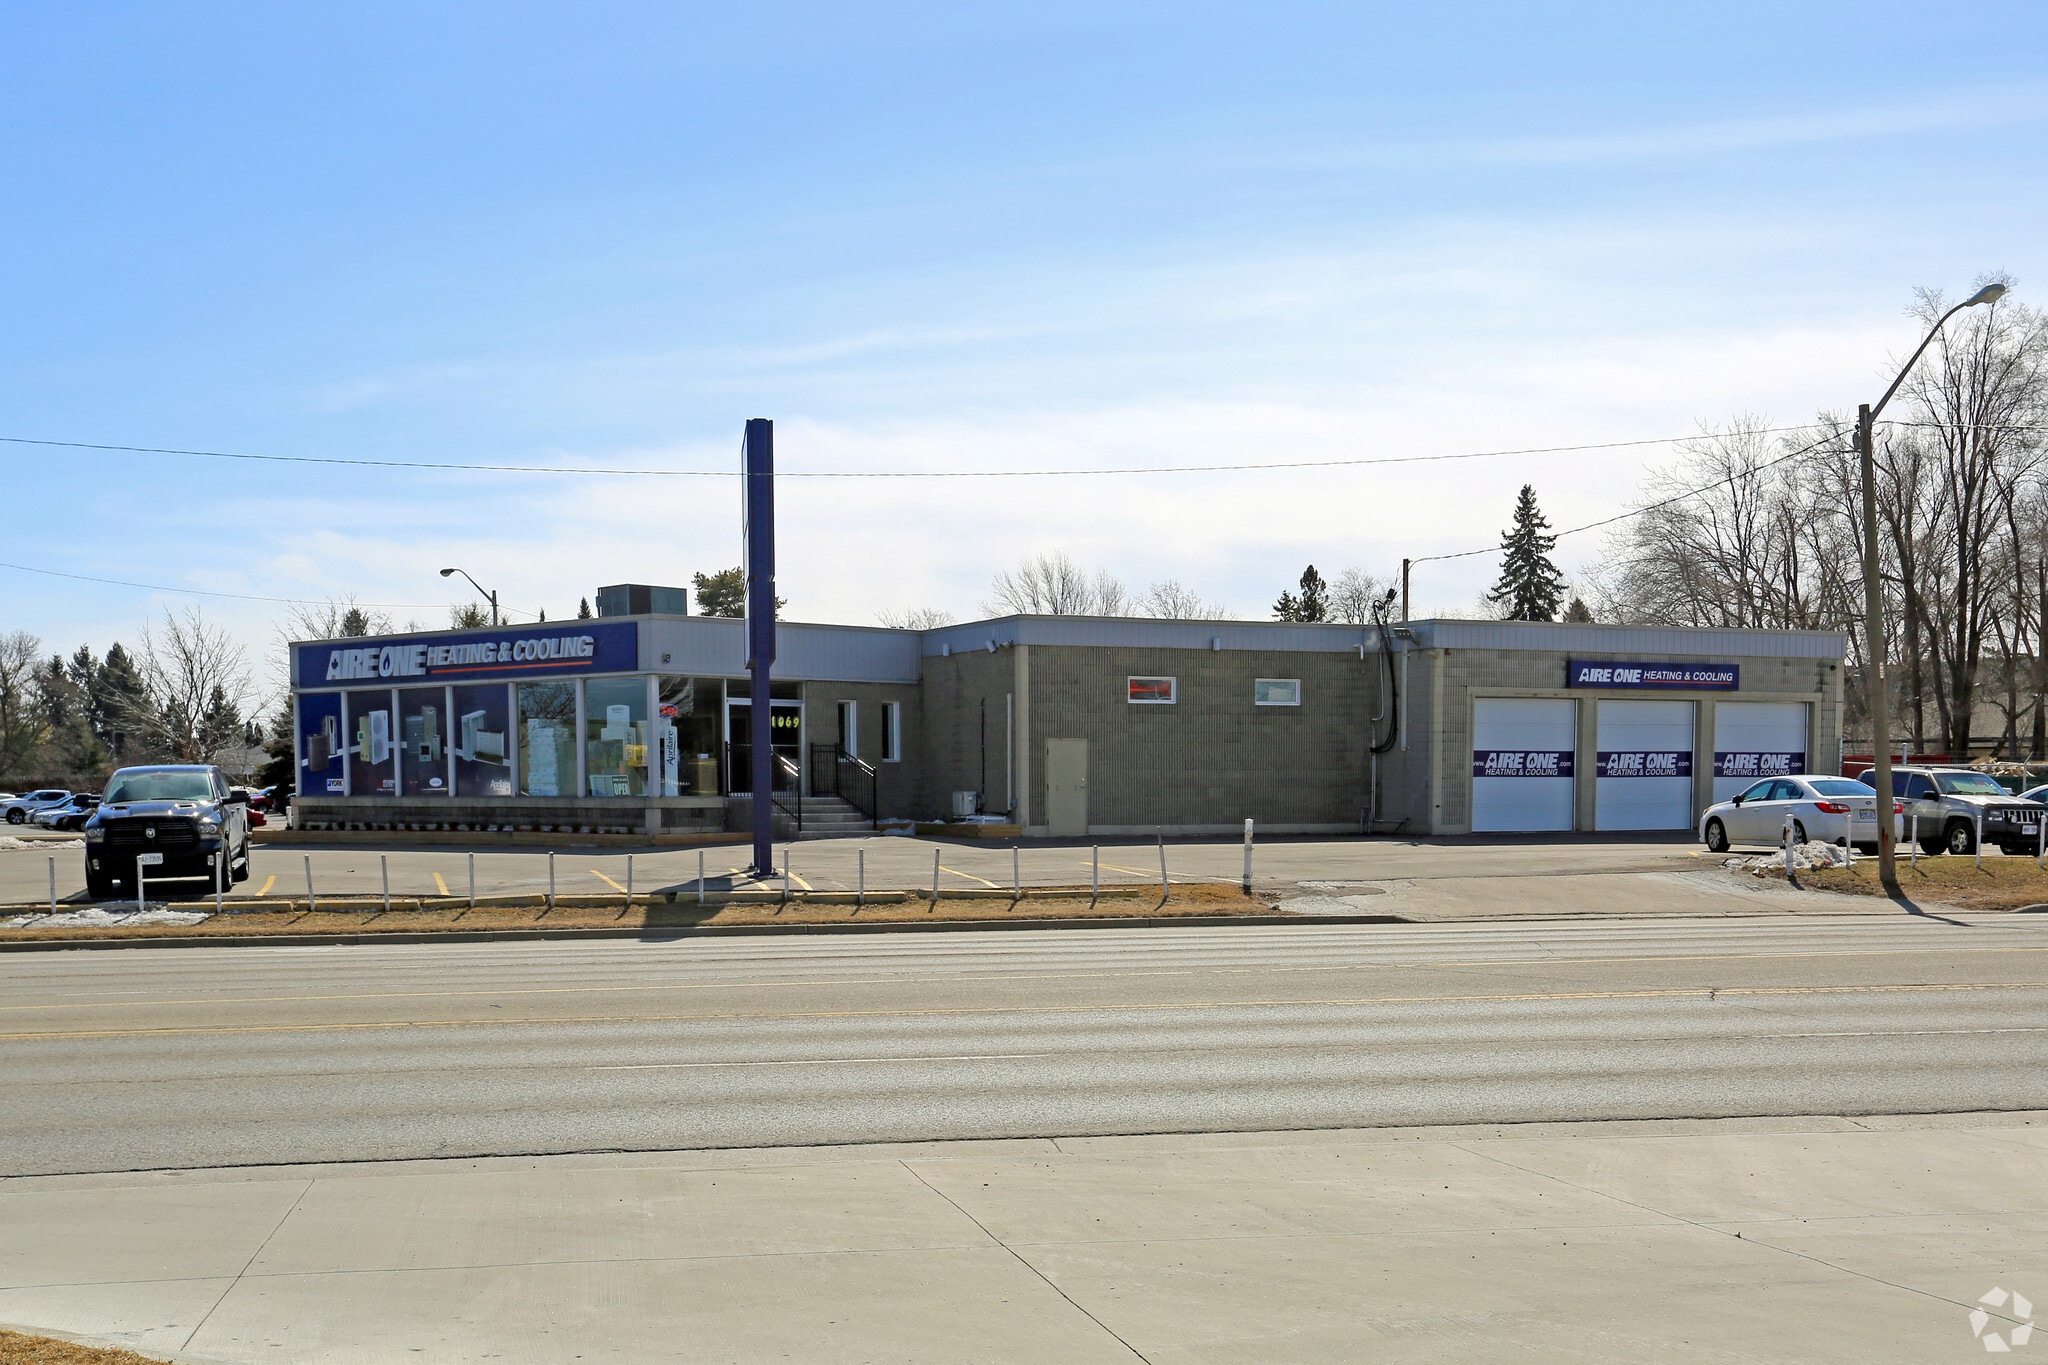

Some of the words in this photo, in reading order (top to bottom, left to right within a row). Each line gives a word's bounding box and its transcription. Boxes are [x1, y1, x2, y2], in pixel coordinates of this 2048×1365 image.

[326, 648, 380, 680] AIRE
[379, 644, 428, 677] ONE
[427, 642, 498, 666] HEATING
[497, 641, 513, 662] &
[513, 635, 594, 661] COOLING
[1578, 668, 1611, 683] AIRE
[1613, 668, 1642, 683] ONE
[1643, 670, 1682, 681] HEATING
[1684, 671, 1691, 681] &
[1692, 671, 1733, 682] COOLING
[771, 715, 800, 728] 1069
[667, 730, 676, 766] Aprilaire
[1485, 752, 1525, 769] AIRE
[1526, 752, 1559, 769] ONE
[1607, 753, 1645, 769] AIRE
[1646, 753, 1678, 769] ONE
[1723, 754, 1759, 769] AIRE
[1760, 754, 1791, 769] ONE
[1485, 768, 1517, 776] HEATING
[1518, 768, 1524, 776] &
[1525, 768, 1559, 776] COOLING
[1607, 768, 1638, 776] HEATING
[1638, 768, 1644, 776] &
[1645, 768, 1677, 776] COOLING
[1723, 768, 1753, 776] HEATING
[1759, 768, 1790, 776] COOLING
[613, 783, 629, 796] OPEN
